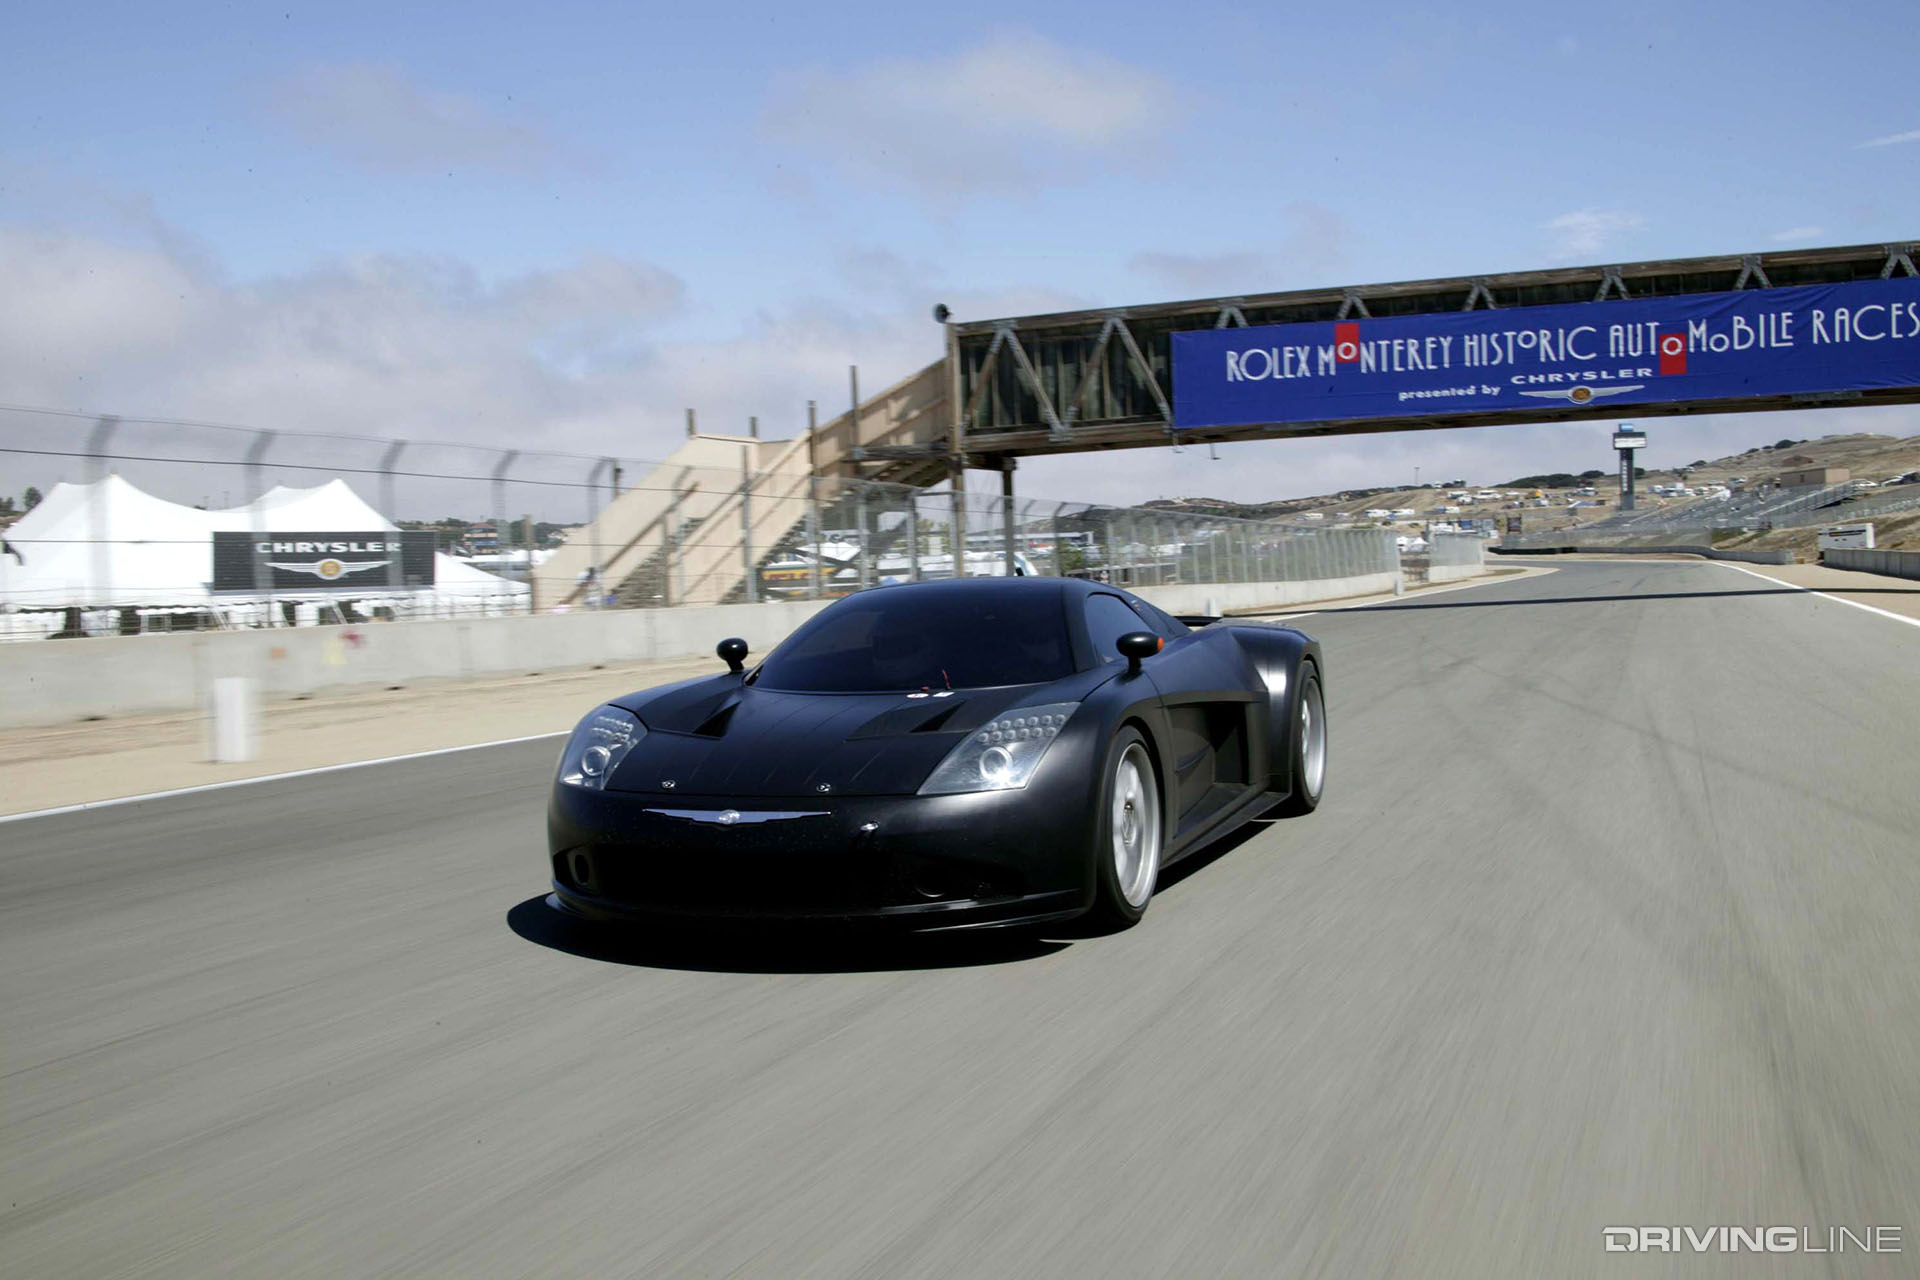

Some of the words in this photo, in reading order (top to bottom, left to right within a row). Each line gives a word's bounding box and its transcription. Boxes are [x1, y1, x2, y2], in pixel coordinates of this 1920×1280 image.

[1226, 345, 1311, 382] ROLEX
[1318, 335, 1453, 376] MONTEREY
[1464, 326, 1597, 367] HISTORIC
[1812, 302, 1920, 344] RACES
[1510, 367, 1653, 384] CHRYSLER
[1398, 385, 1477, 401] presented
[1482, 384, 1501, 396] by
[255, 542, 403, 553] CHRYSLER
